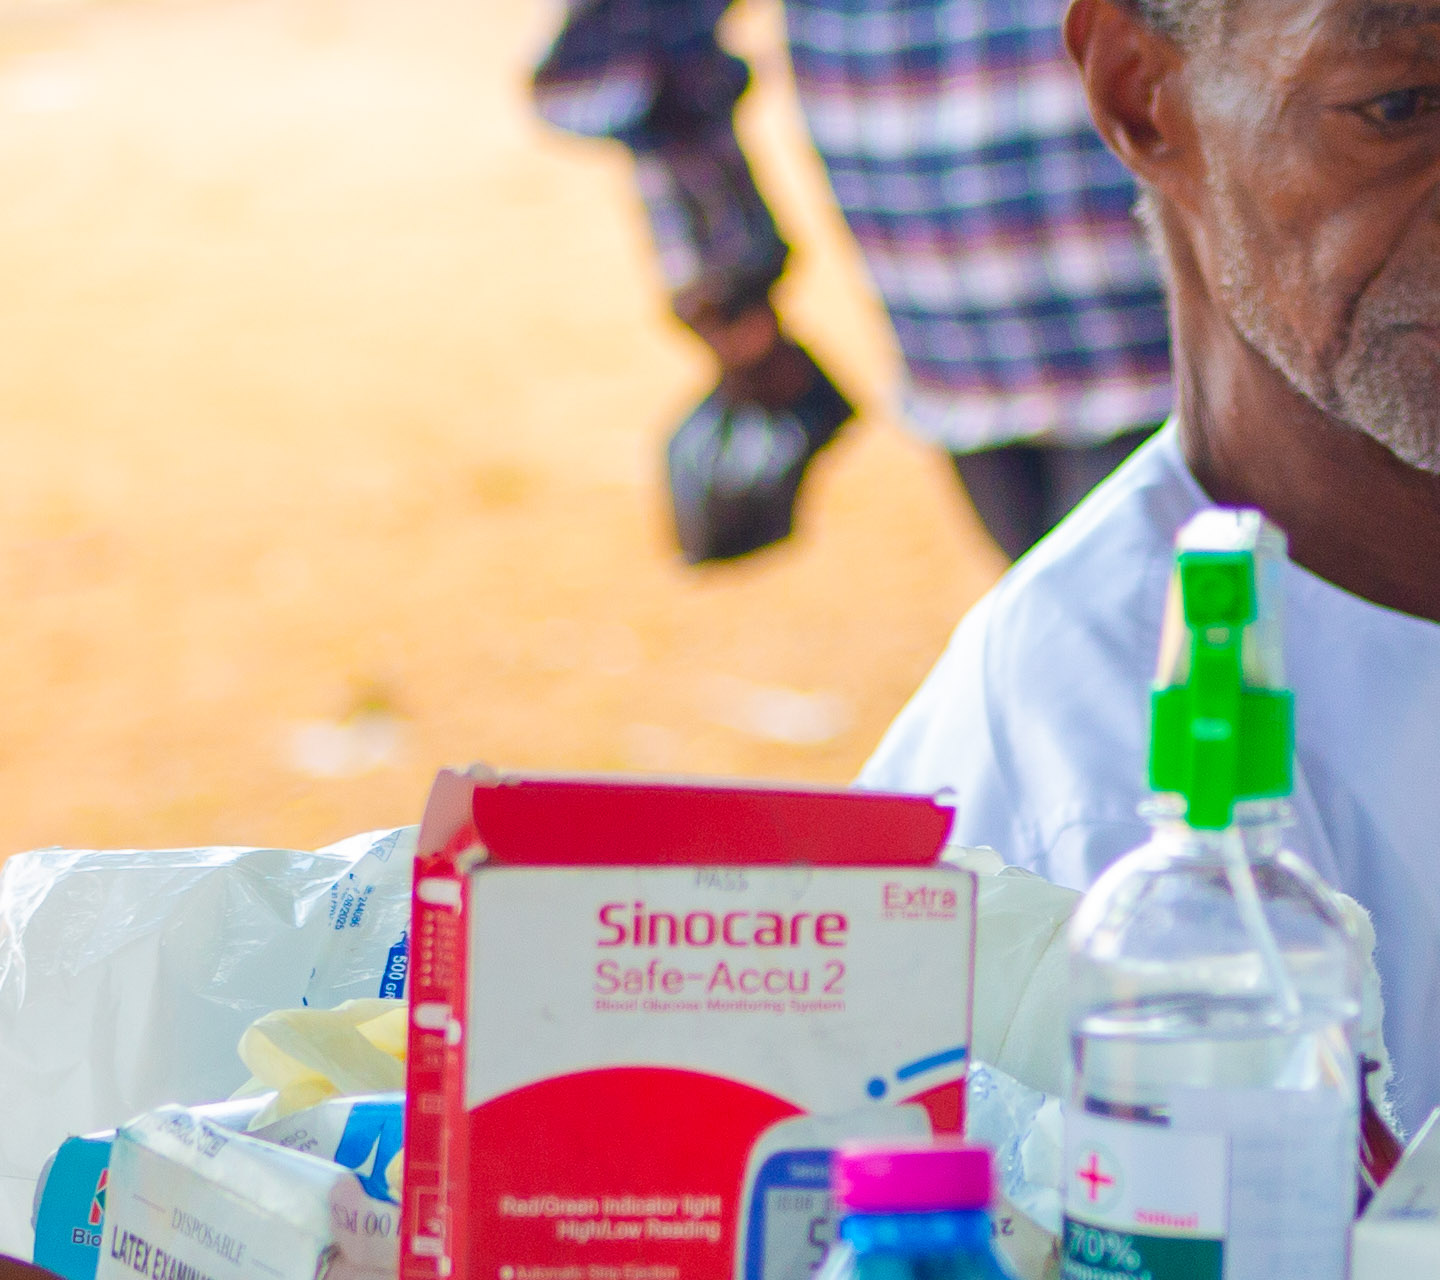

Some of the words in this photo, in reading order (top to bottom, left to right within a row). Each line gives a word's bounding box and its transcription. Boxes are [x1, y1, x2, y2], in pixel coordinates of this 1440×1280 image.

[881, 881, 957, 911] Extra
[596, 901, 849, 949] Sinocare
[389, 954, 408, 981] 500
[595, 960, 811, 996] Safe-Accu
[823, 961, 847, 995] 2
[706, 999, 785, 1013] Monitoring
[112, 1225, 150, 1274] LATEX
[171, 1208, 247, 1265] DISPOSABLE
[1070, 1225, 1141, 1270] 70%
